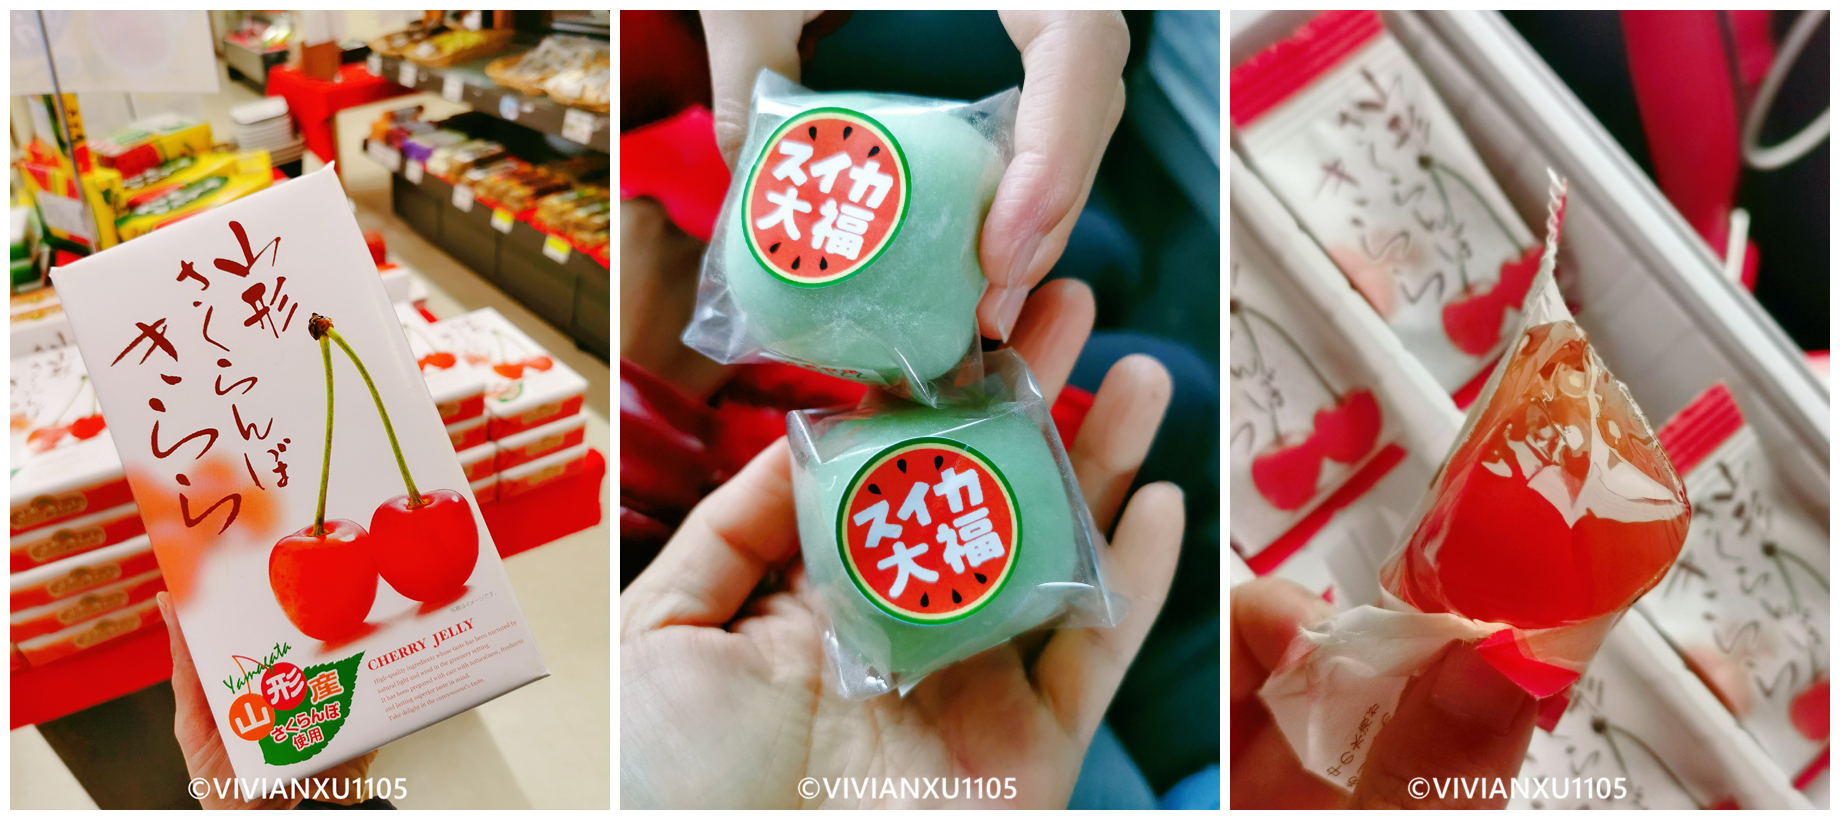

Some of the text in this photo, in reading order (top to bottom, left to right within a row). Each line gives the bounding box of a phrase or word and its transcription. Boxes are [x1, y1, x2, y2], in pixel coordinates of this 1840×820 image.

[772, 140, 894, 210] スイカ
[755, 185, 876, 262] 大福
[213, 220, 299, 339] 山形
[176, 259, 292, 492] さくらんぼ
[110, 317, 243, 536] きらら
[853, 467, 984, 548] スイカ
[877, 506, 1005, 599] 大福
[223, 642, 291, 694] Yamagata
[368, 618, 473, 670] CHERRY JELLY
[378, 682, 396, 693] natural
[396, 676, 409, 685] light
[410, 671, 419, 680] and
[420, 665, 433, 675] wind
[440, 660, 448, 668] the
[449, 651, 471, 664] greenery
[386, 693, 396, 701] has
[396, 688, 409, 696] been
[410, 677, 433, 692] prepared
[434, 672, 445, 680] with
[446, 668, 456, 676] care
[457, 662, 469, 670] with
[500, 640, 524, 652] freshness
[406, 656, 435, 670] ingredients
[436, 648, 451, 658] whose
[452, 643, 464, 651] taste
[465, 639, 474, 647] has
[474, 633, 487, 641] been
[488, 622, 510, 636] nurtured
[270, 702, 341, 743] さくらんぼ
[385, 703, 395, 712] and
[395, 698, 414, 708] lasting
[414, 688, 435, 700] superior
[436, 682, 448, 691] taste
[388, 712, 401, 721] Take
[402, 705, 420, 715] delight
[427, 698, 435, 706] the
[292, 726, 324, 751] 使用
